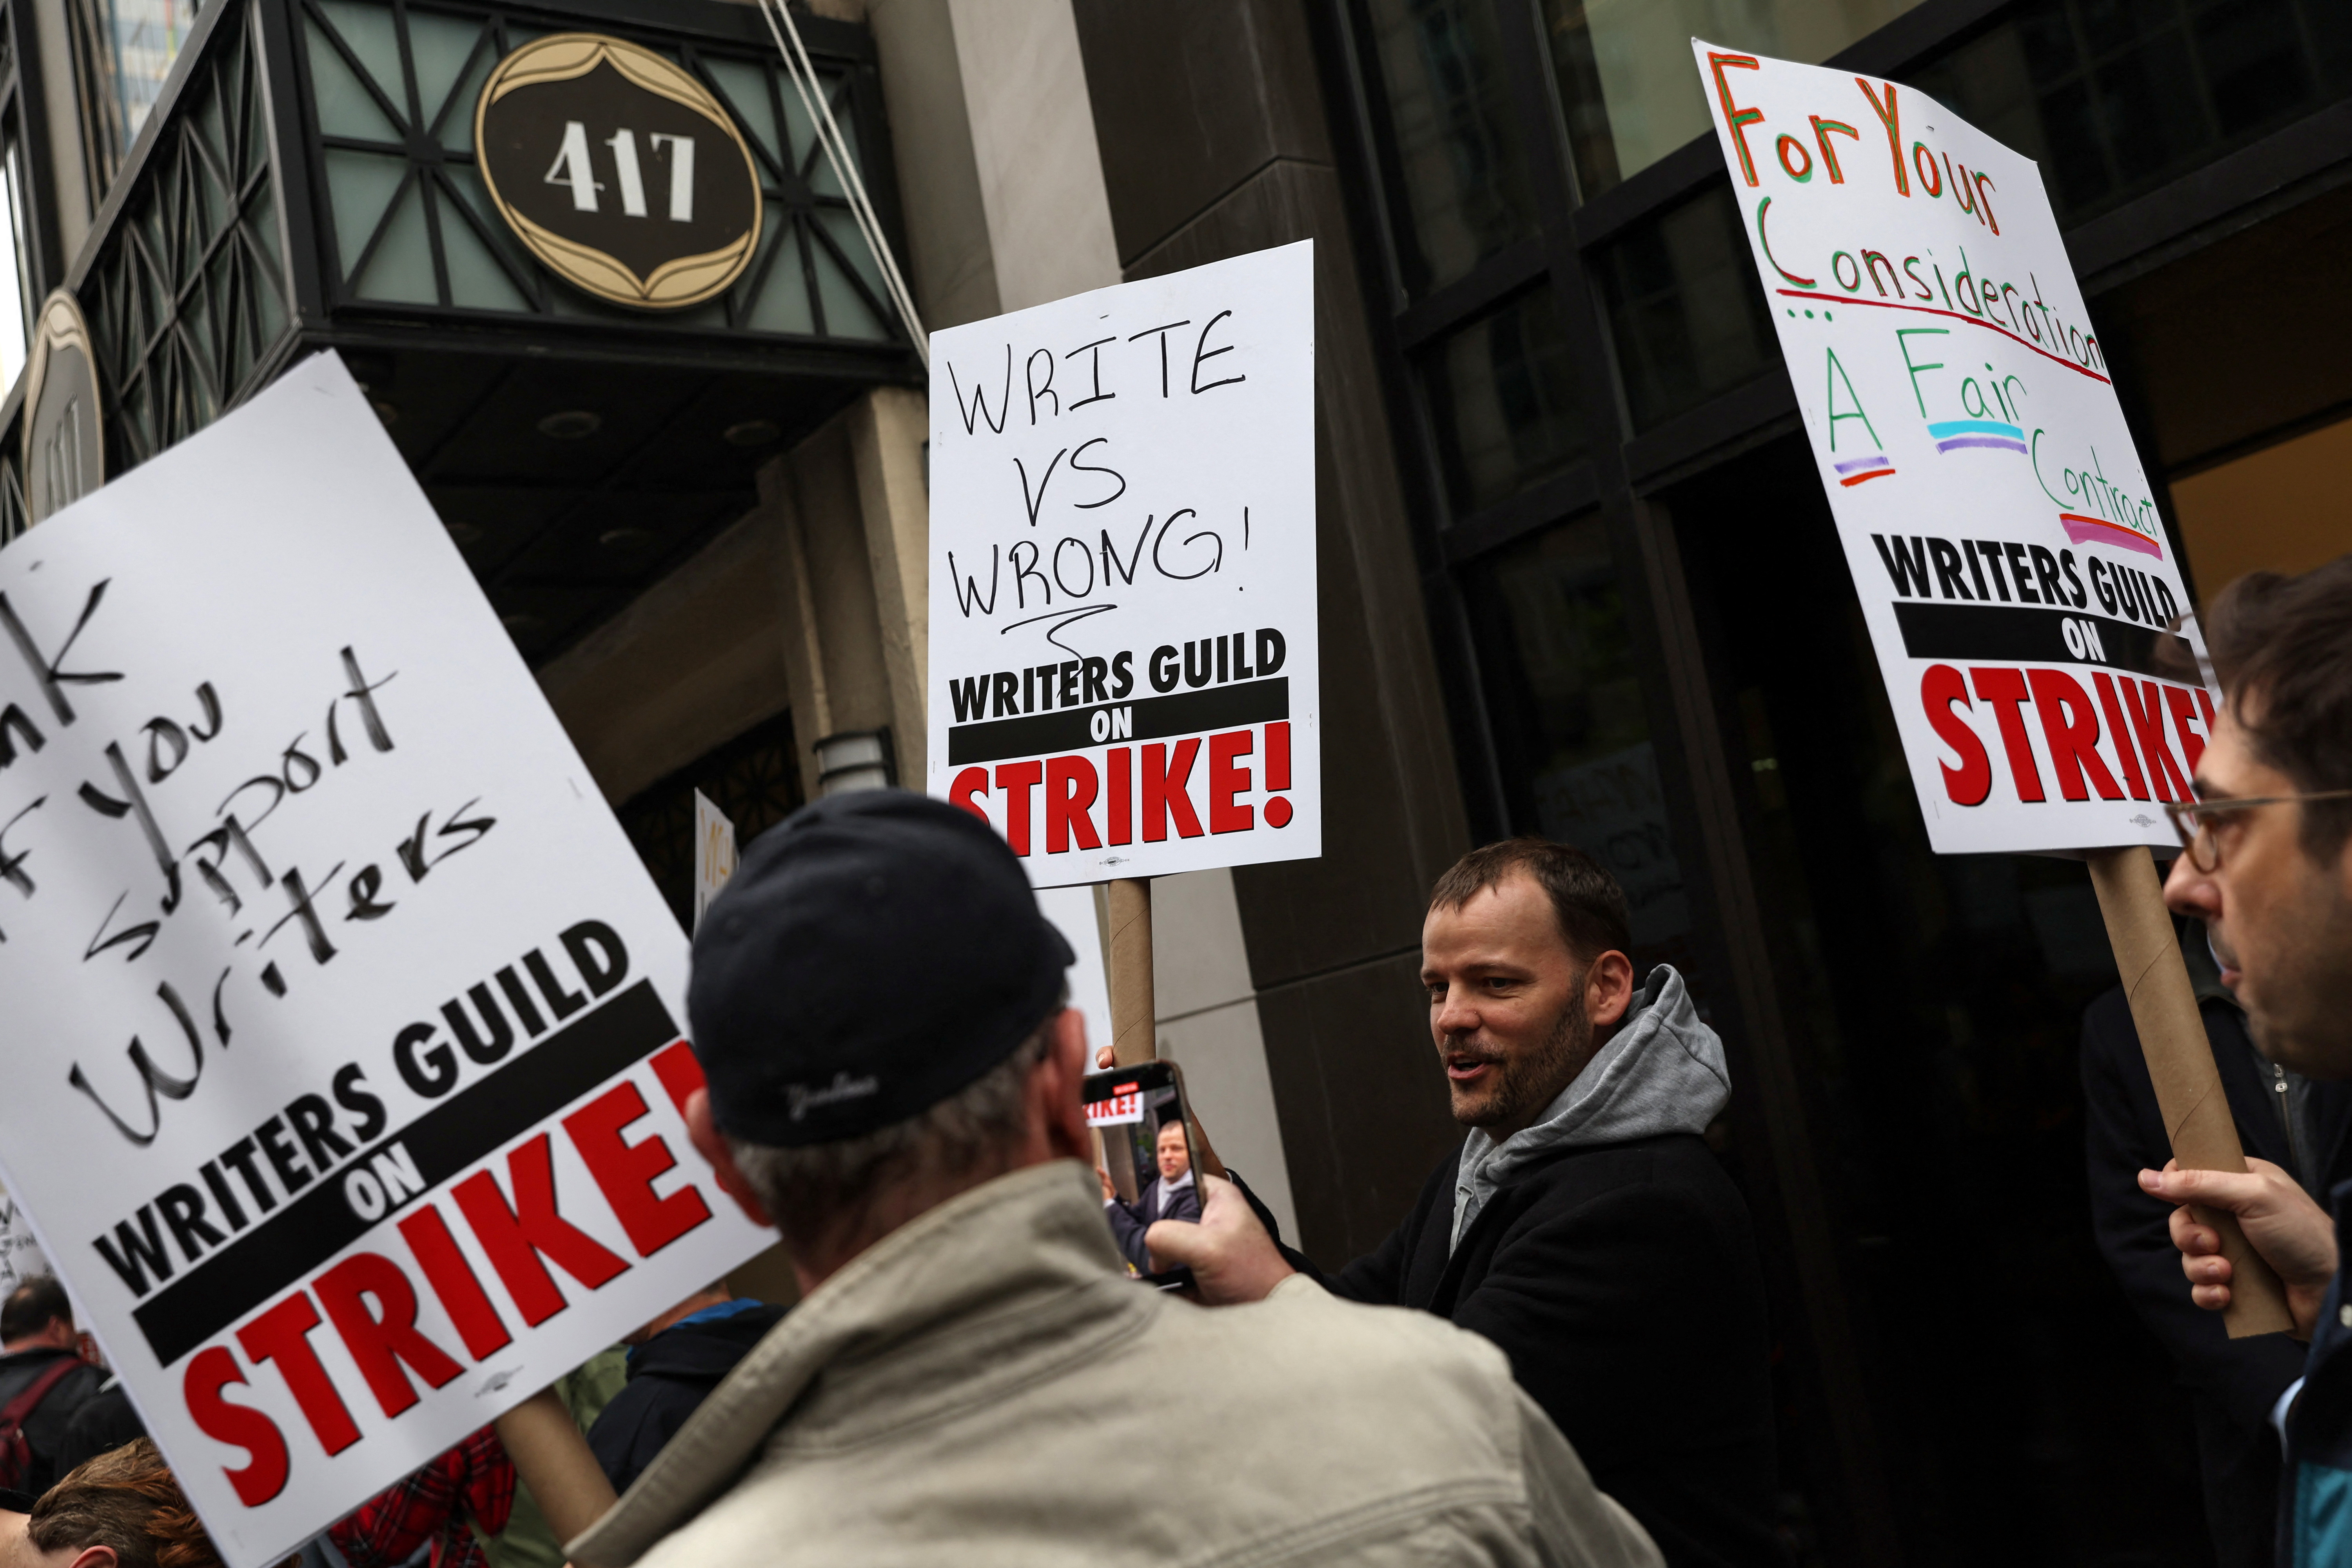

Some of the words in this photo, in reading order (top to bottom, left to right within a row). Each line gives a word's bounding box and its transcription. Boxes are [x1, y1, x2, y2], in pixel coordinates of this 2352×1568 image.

[544, 120, 695, 223] 417
[1707, 51, 1859, 187] For
[1855, 77, 1999, 236] Your
[1757, 197, 2105, 368] Consideration
[948, 310, 1245, 435] WRITE
[1827, 347, 1883, 452] A
[1896, 328, 2027, 423] Fair
[1013, 438, 1125, 526] VS
[2031, 429, 2157, 536] Contract
[948, 506, 1249, 617] WRONG!
[1871, 534, 2087, 609] WRITERS
[2088, 556, 2181, 632] GUILD
[949, 651, 1134, 722] WRITERS
[1149, 628, 1286, 693] GUILD
[2062, 617, 2107, 661] ON
[1090, 706, 1132, 742] ON
[92, 1062, 387, 1298] WRITERS
[393, 919, 629, 1098] GUILD
[344, 1142, 426, 1221] ON
